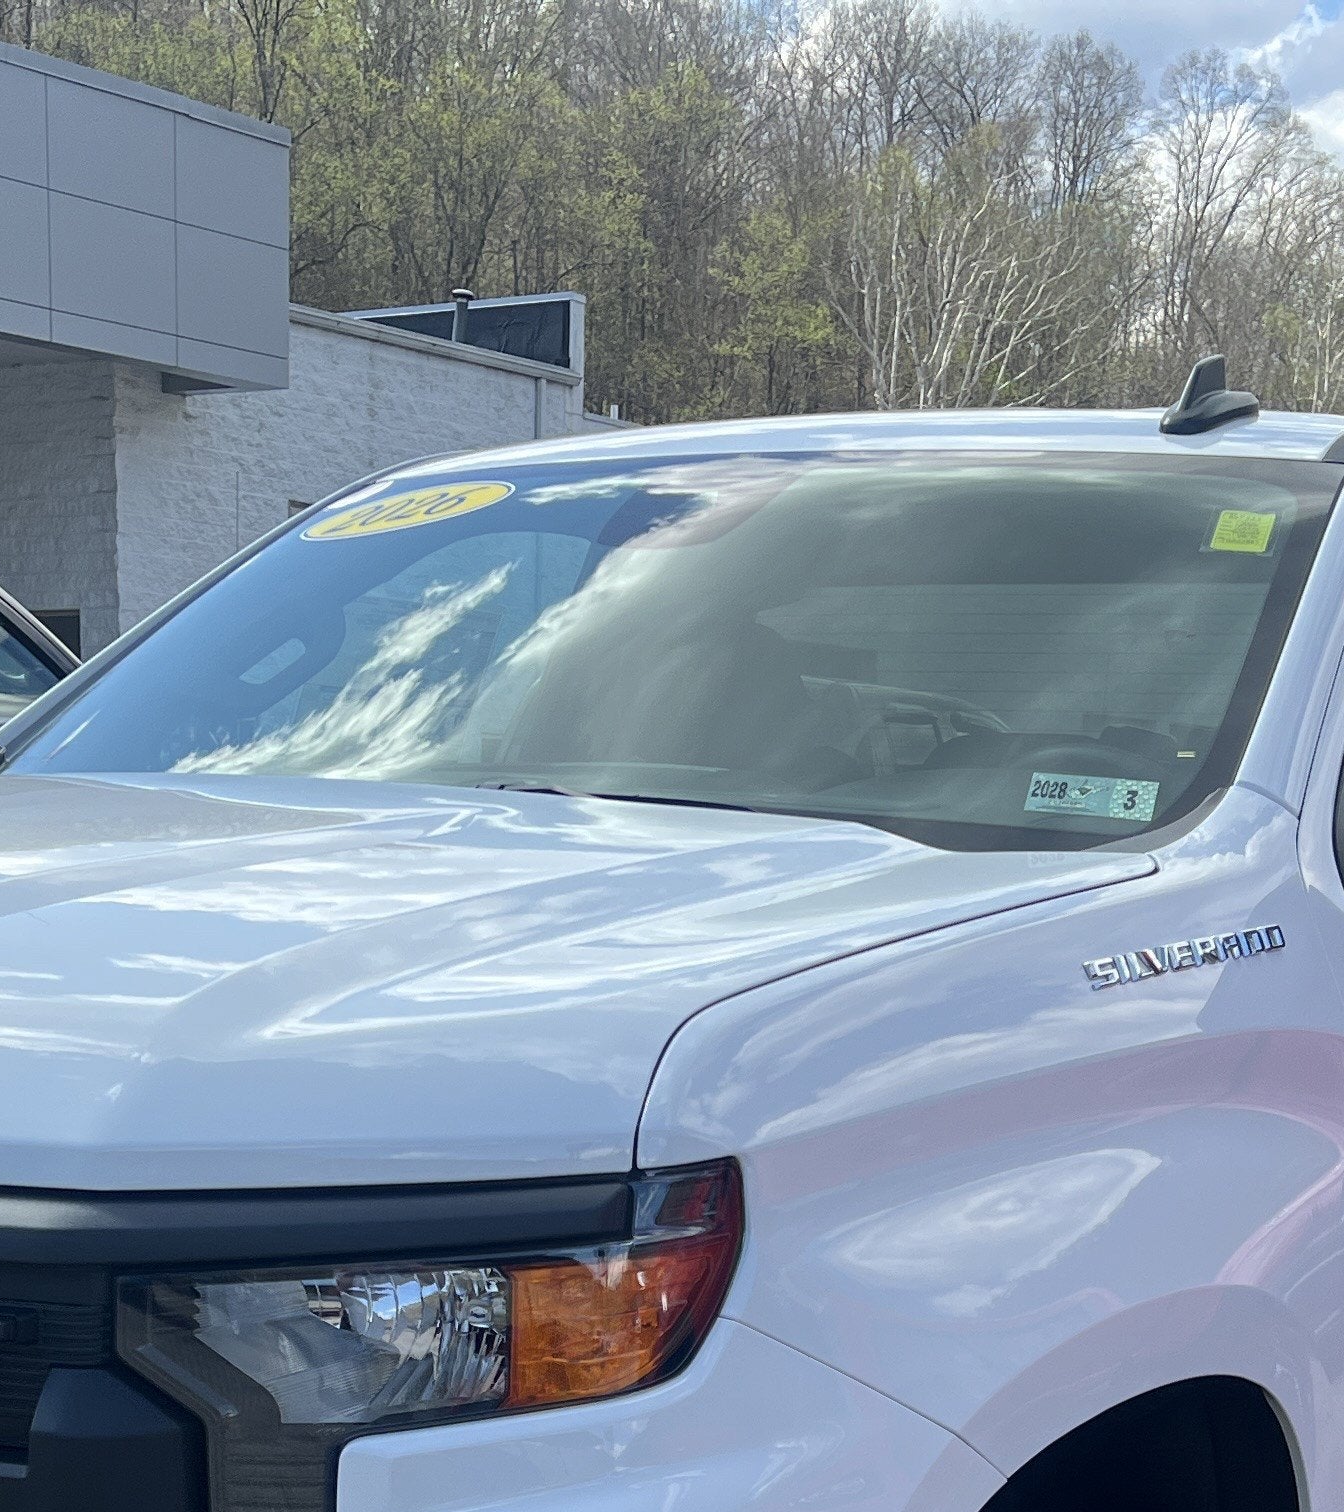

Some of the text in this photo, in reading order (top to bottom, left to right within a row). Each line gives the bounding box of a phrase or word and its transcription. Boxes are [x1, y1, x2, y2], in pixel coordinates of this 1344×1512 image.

[321, 486, 491, 535] 2026
[1031, 780, 1068, 799] 2028
[1123, 790, 1138, 811] 3
[1083, 925, 1286, 991] SILVERADO
